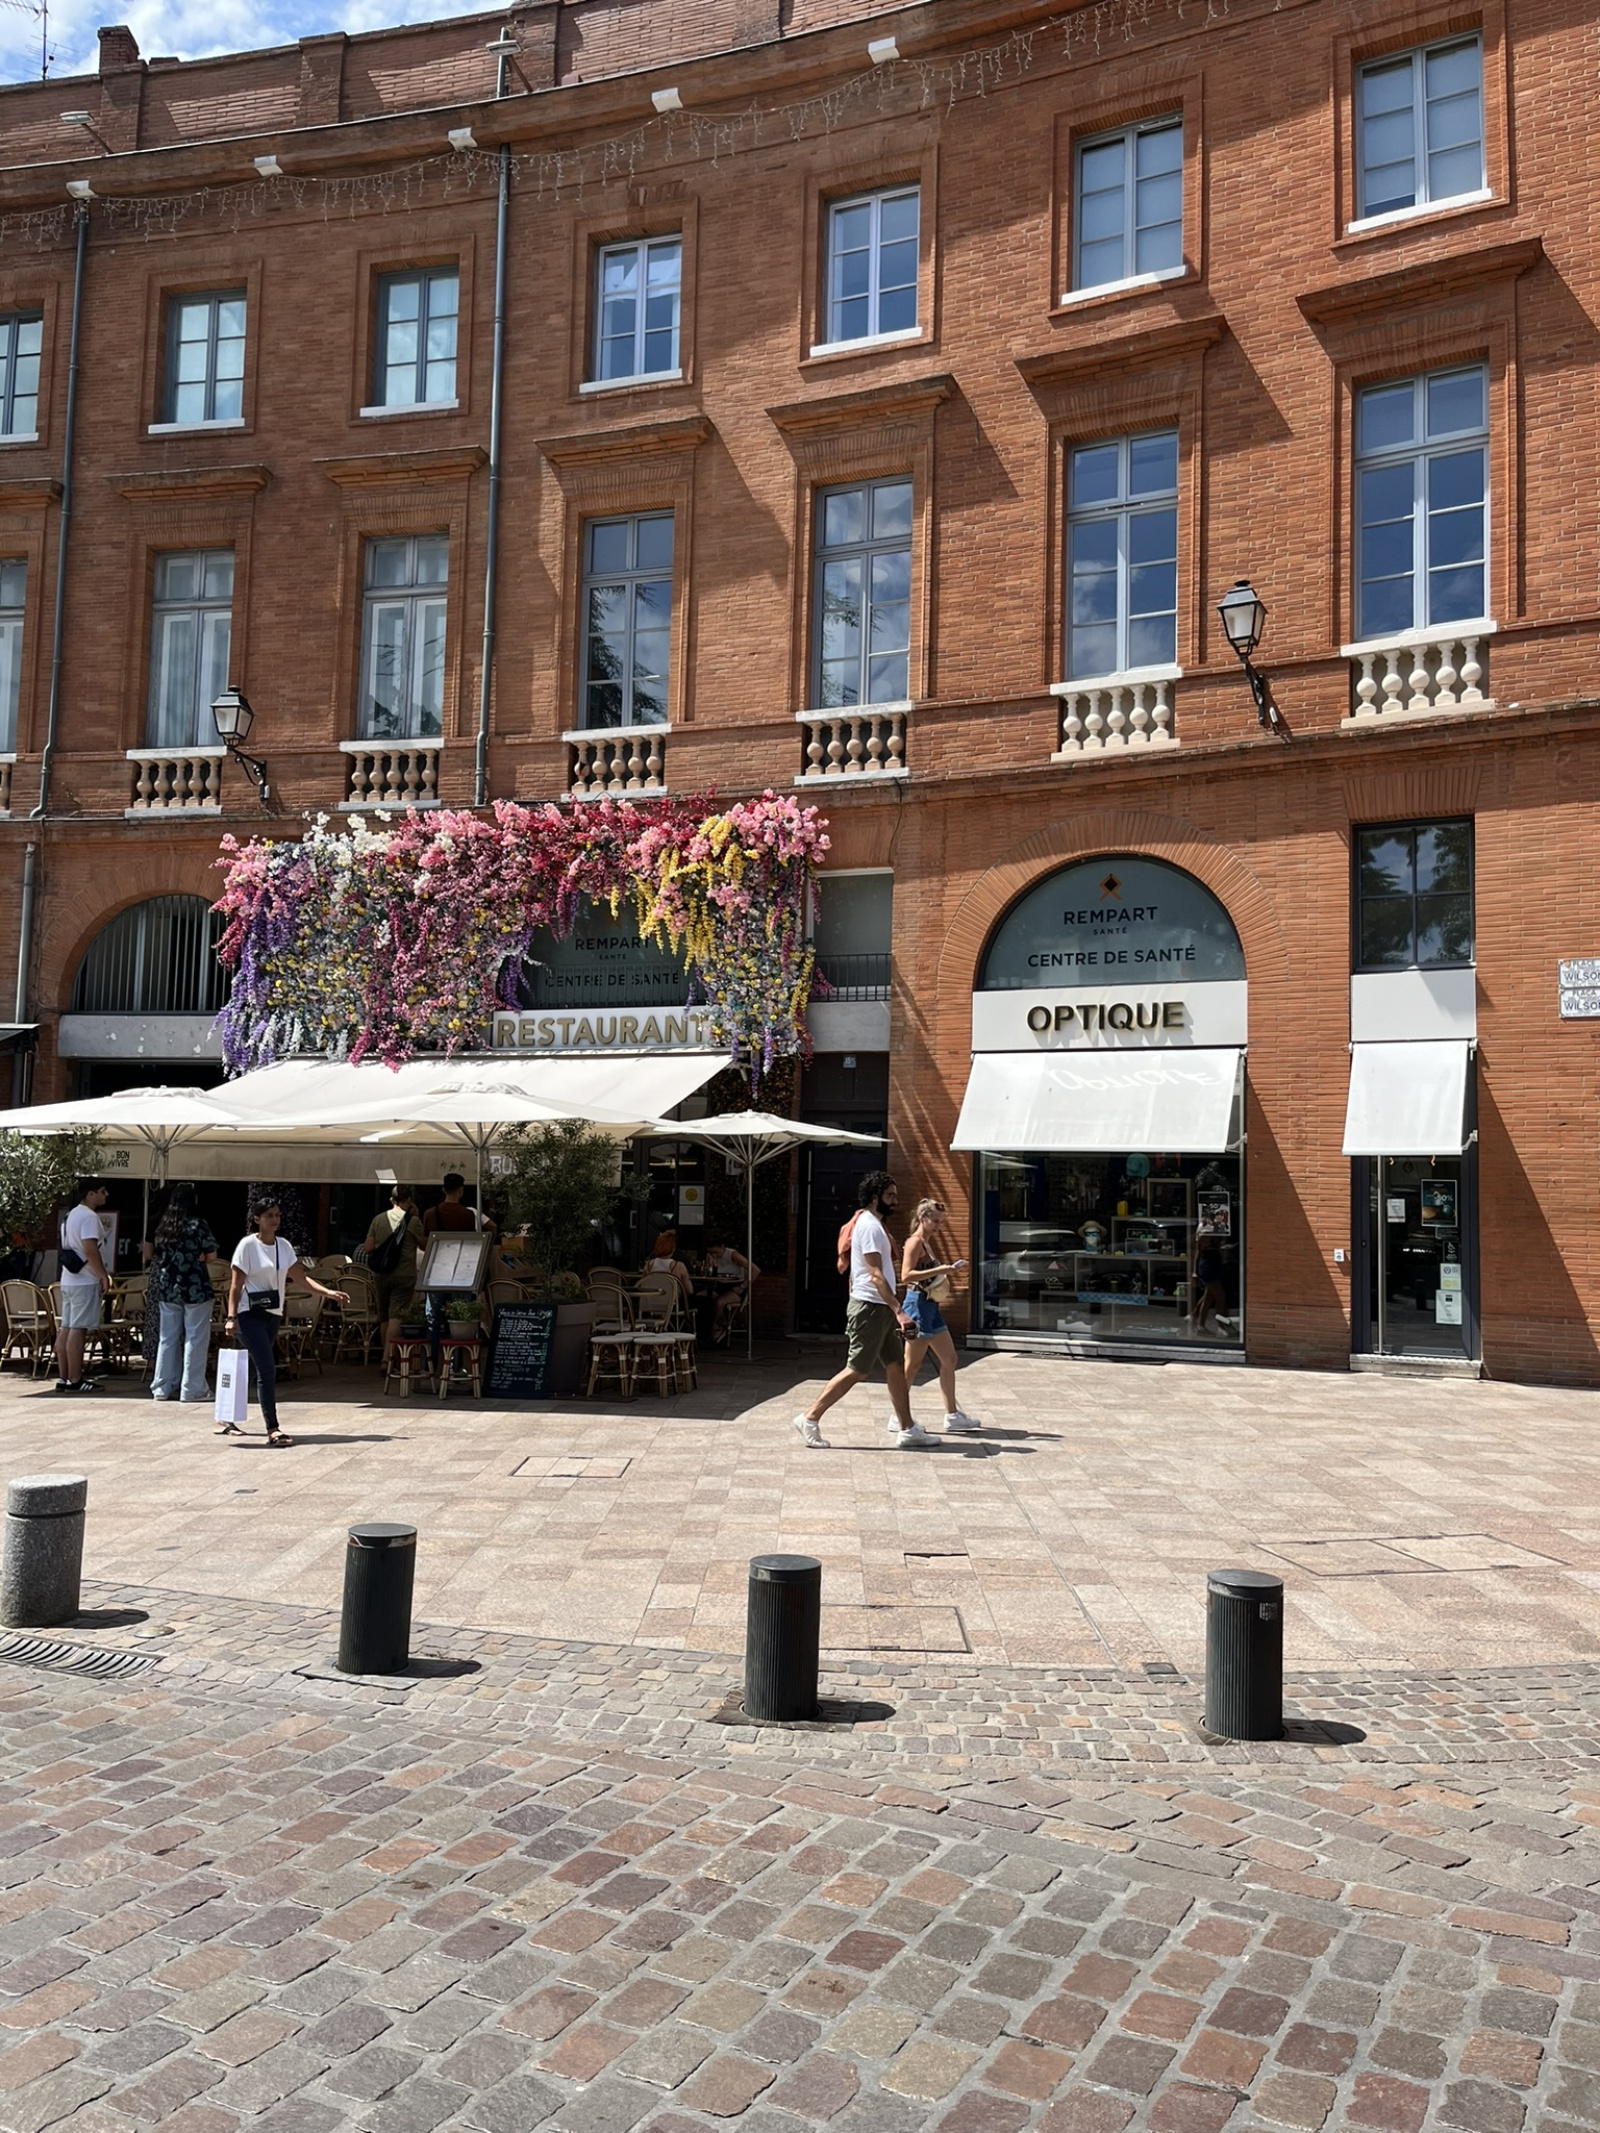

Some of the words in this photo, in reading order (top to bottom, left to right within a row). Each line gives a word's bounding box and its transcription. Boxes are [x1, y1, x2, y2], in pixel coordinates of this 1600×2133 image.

[1064, 906, 1158, 925] REMPART
[1093, 926, 1127, 936] SANTÉ
[1027, 952, 1098, 967] CENTRE
[1104, 950, 1128, 964] DE
[1134, 944, 1196, 963] SANTÉ
[545, 973, 603, 987] CENTRE
[608, 973, 626, 986] DE
[631, 968, 679, 986] SANTÉ
[1564, 1001, 1600, 1011] WILSO
[1026, 1001, 1185, 1031] OPTIQUE
[496, 1015, 709, 1046] RESTAURANT
